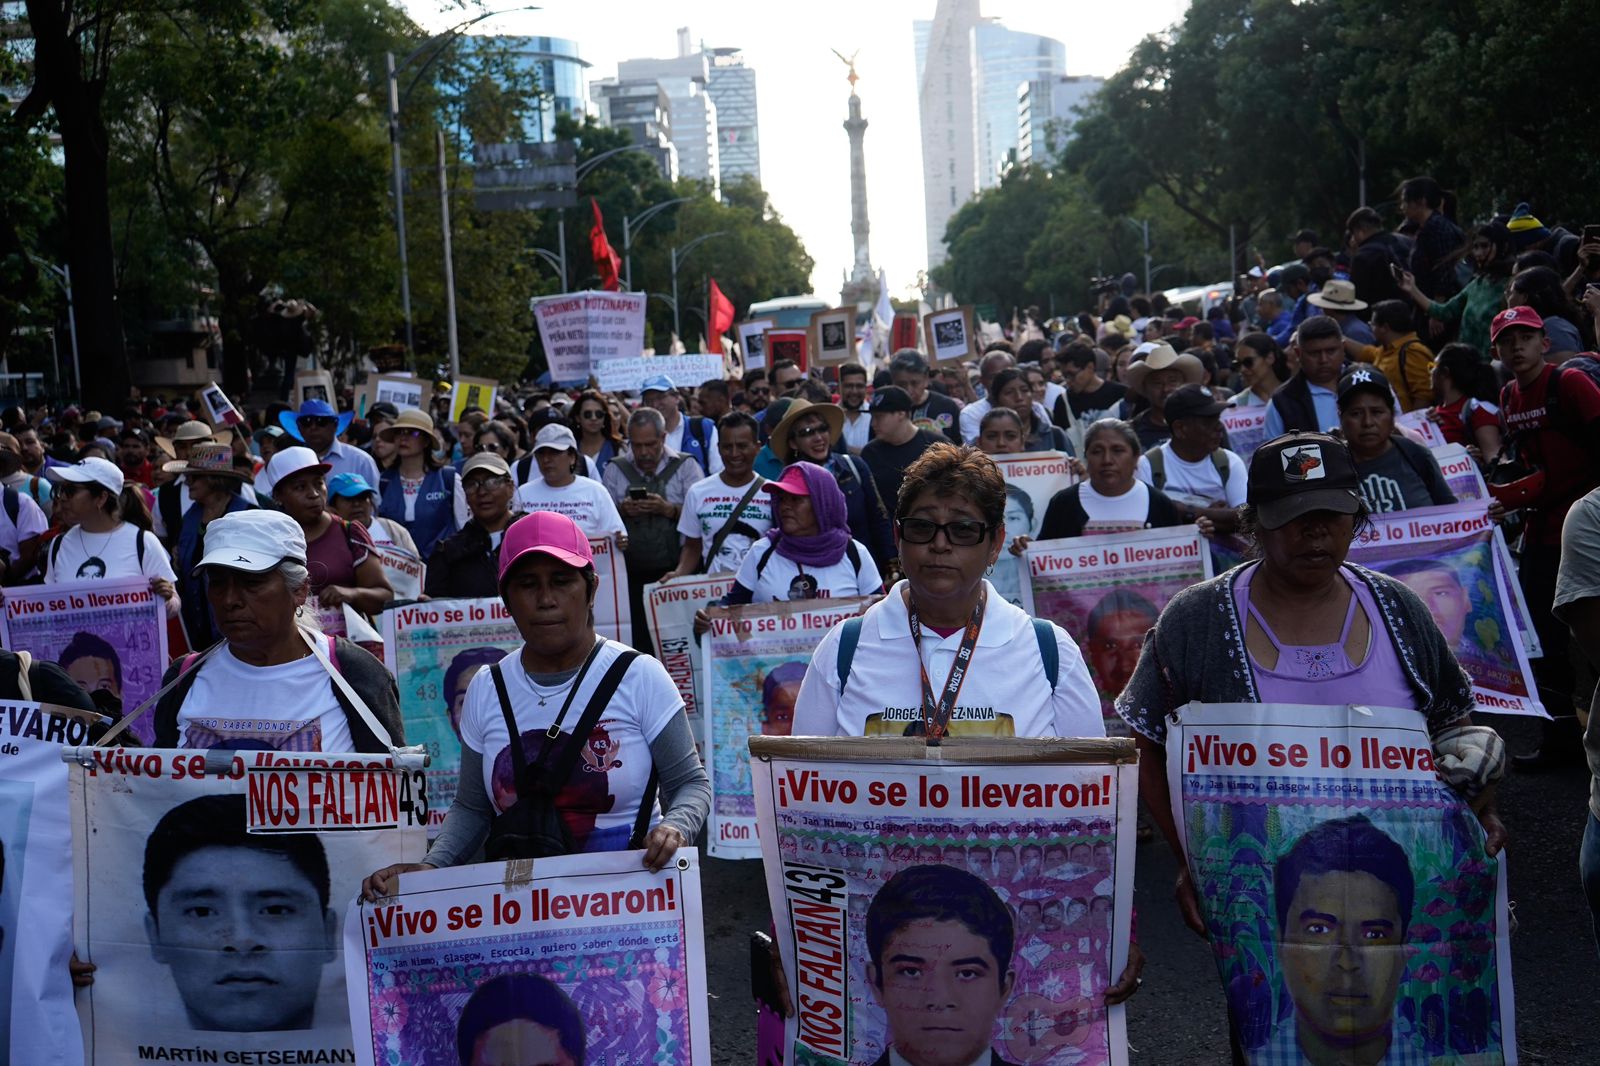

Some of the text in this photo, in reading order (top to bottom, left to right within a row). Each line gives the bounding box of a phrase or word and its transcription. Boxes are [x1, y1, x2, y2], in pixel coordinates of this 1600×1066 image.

[1386, 524, 1403, 540] lo
[1031, 555, 1073, 576] ¡Vivo
[1079, 555, 1098, 568] se
[1103, 550, 1119, 565] lo
[1124, 540, 1199, 563] llevaron!
[7, 599, 44, 619] ¡Vivo
[49, 597, 66, 611] se
[69, 595, 84, 609] lo
[87, 587, 155, 608] llevaron!
[655, 589, 688, 606] ¡Vivo
[692, 588, 706, 600] se
[710, 584, 722, 597] lo
[397, 608, 439, 630] ¡Vivo
[444, 609, 464, 624] se
[469, 605, 485, 620] lo
[758, 618, 775, 632] se
[781, 616, 797, 631] lo
[223, 721, 252, 729] SABER
[883, 707, 916, 720] JORGE
[967, 707, 994, 720] NAVA
[1187, 734, 1438, 773] ¡Vivo se lo lleva
[171, 755, 206, 781] se
[249, 772, 300, 828] NOS
[308, 768, 399, 826] FALTAN
[778, 769, 857, 807] ¡Vivo
[868, 780, 907, 807] se
[919, 775, 949, 808] lo
[961, 775, 1111, 808] llevaron!
[1370, 784, 1407, 795] quiero
[803, 816, 819, 827] Jan
[972, 824, 1009, 835] quiero
[1015, 823, 1046, 833] saber
[368, 877, 676, 948] ¡Vivo se lo llevaron!
[373, 960, 389, 972] Yo,
[393, 958, 409, 969] Jan
[443, 952, 485, 964] Glasgow,
[491, 947, 535, 960] Escocia,
[540, 942, 577, 955] quiero
[582, 939, 613, 950] saber
[618, 935, 649, 948] dónde
[654, 932, 679, 945] está
[793, 898, 842, 997] FALTAN
[800, 993, 843, 1056] NOS
[138, 1045, 217, 1063] MARTÍN
